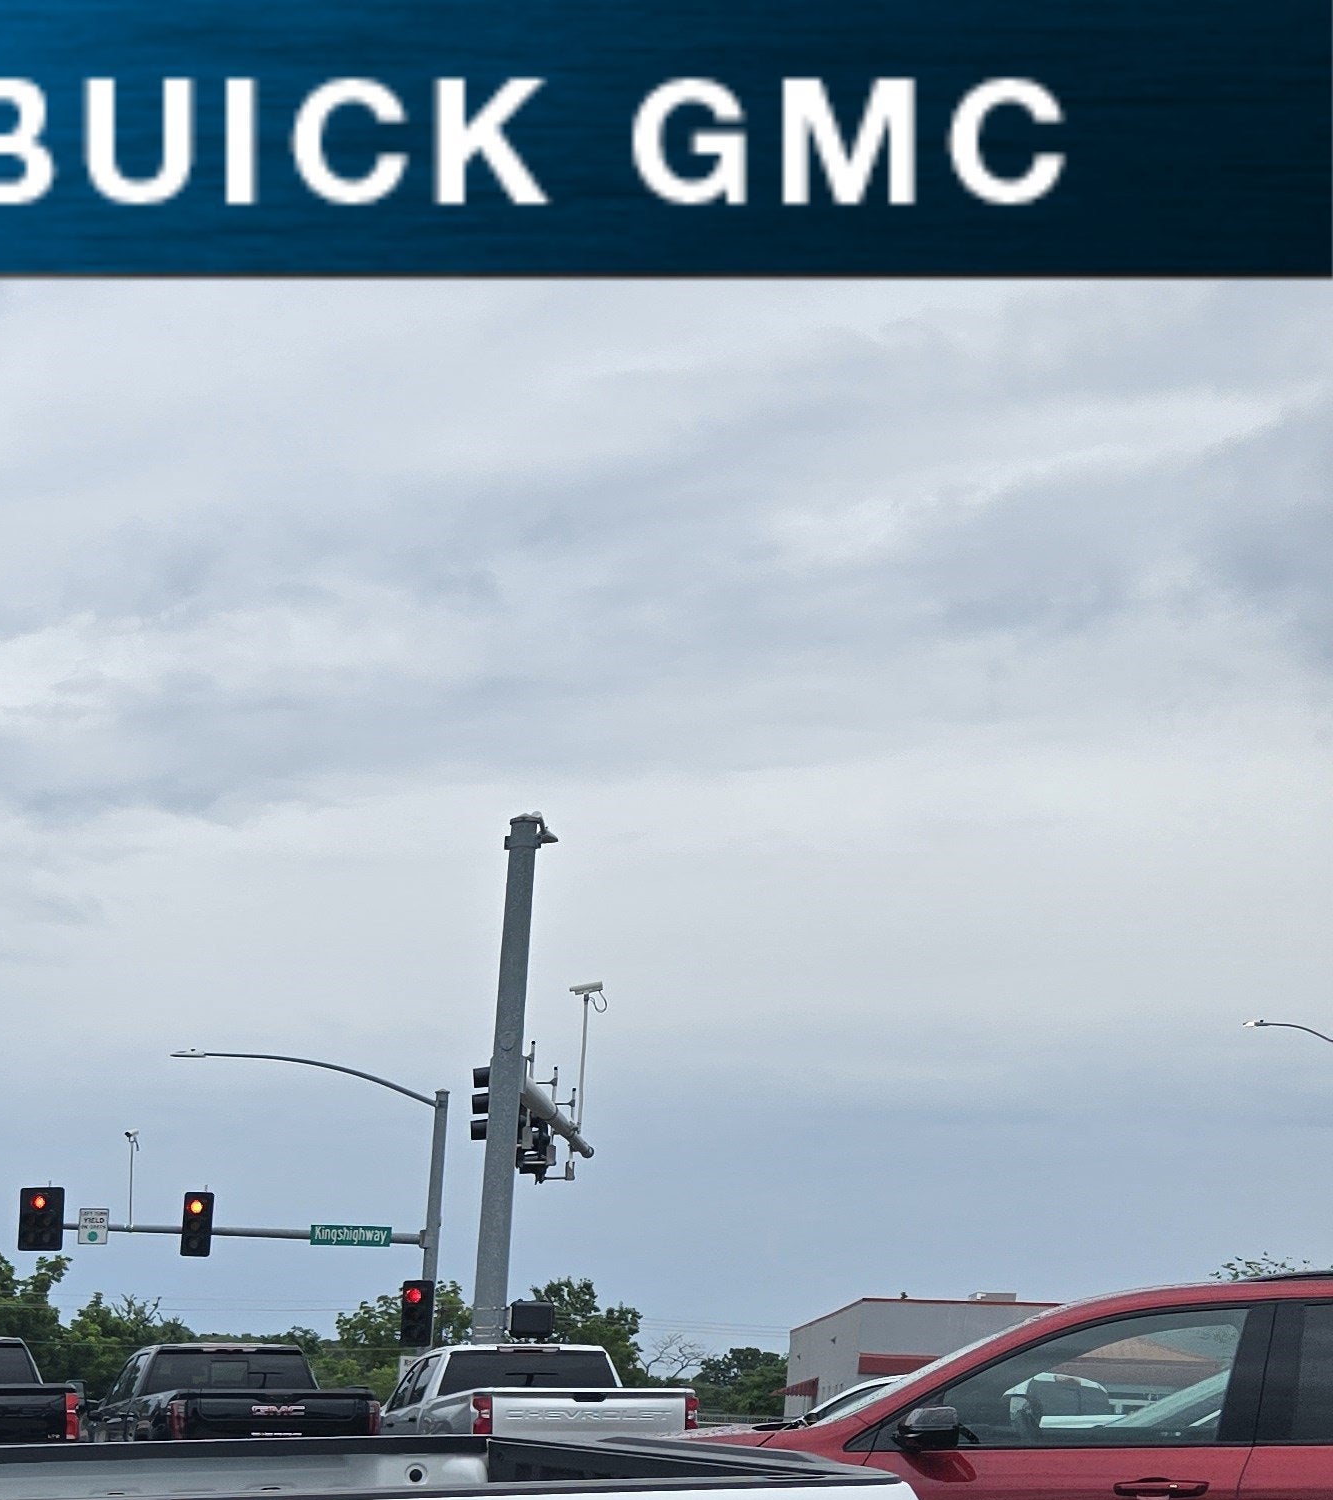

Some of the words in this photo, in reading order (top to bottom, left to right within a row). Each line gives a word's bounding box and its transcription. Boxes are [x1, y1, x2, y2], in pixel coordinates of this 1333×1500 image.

[314, 1226, 388, 1245] Kingshighway
[251, 1405, 306, 1416] GMC
[504, 1408, 673, 1421] CHEVROLET
